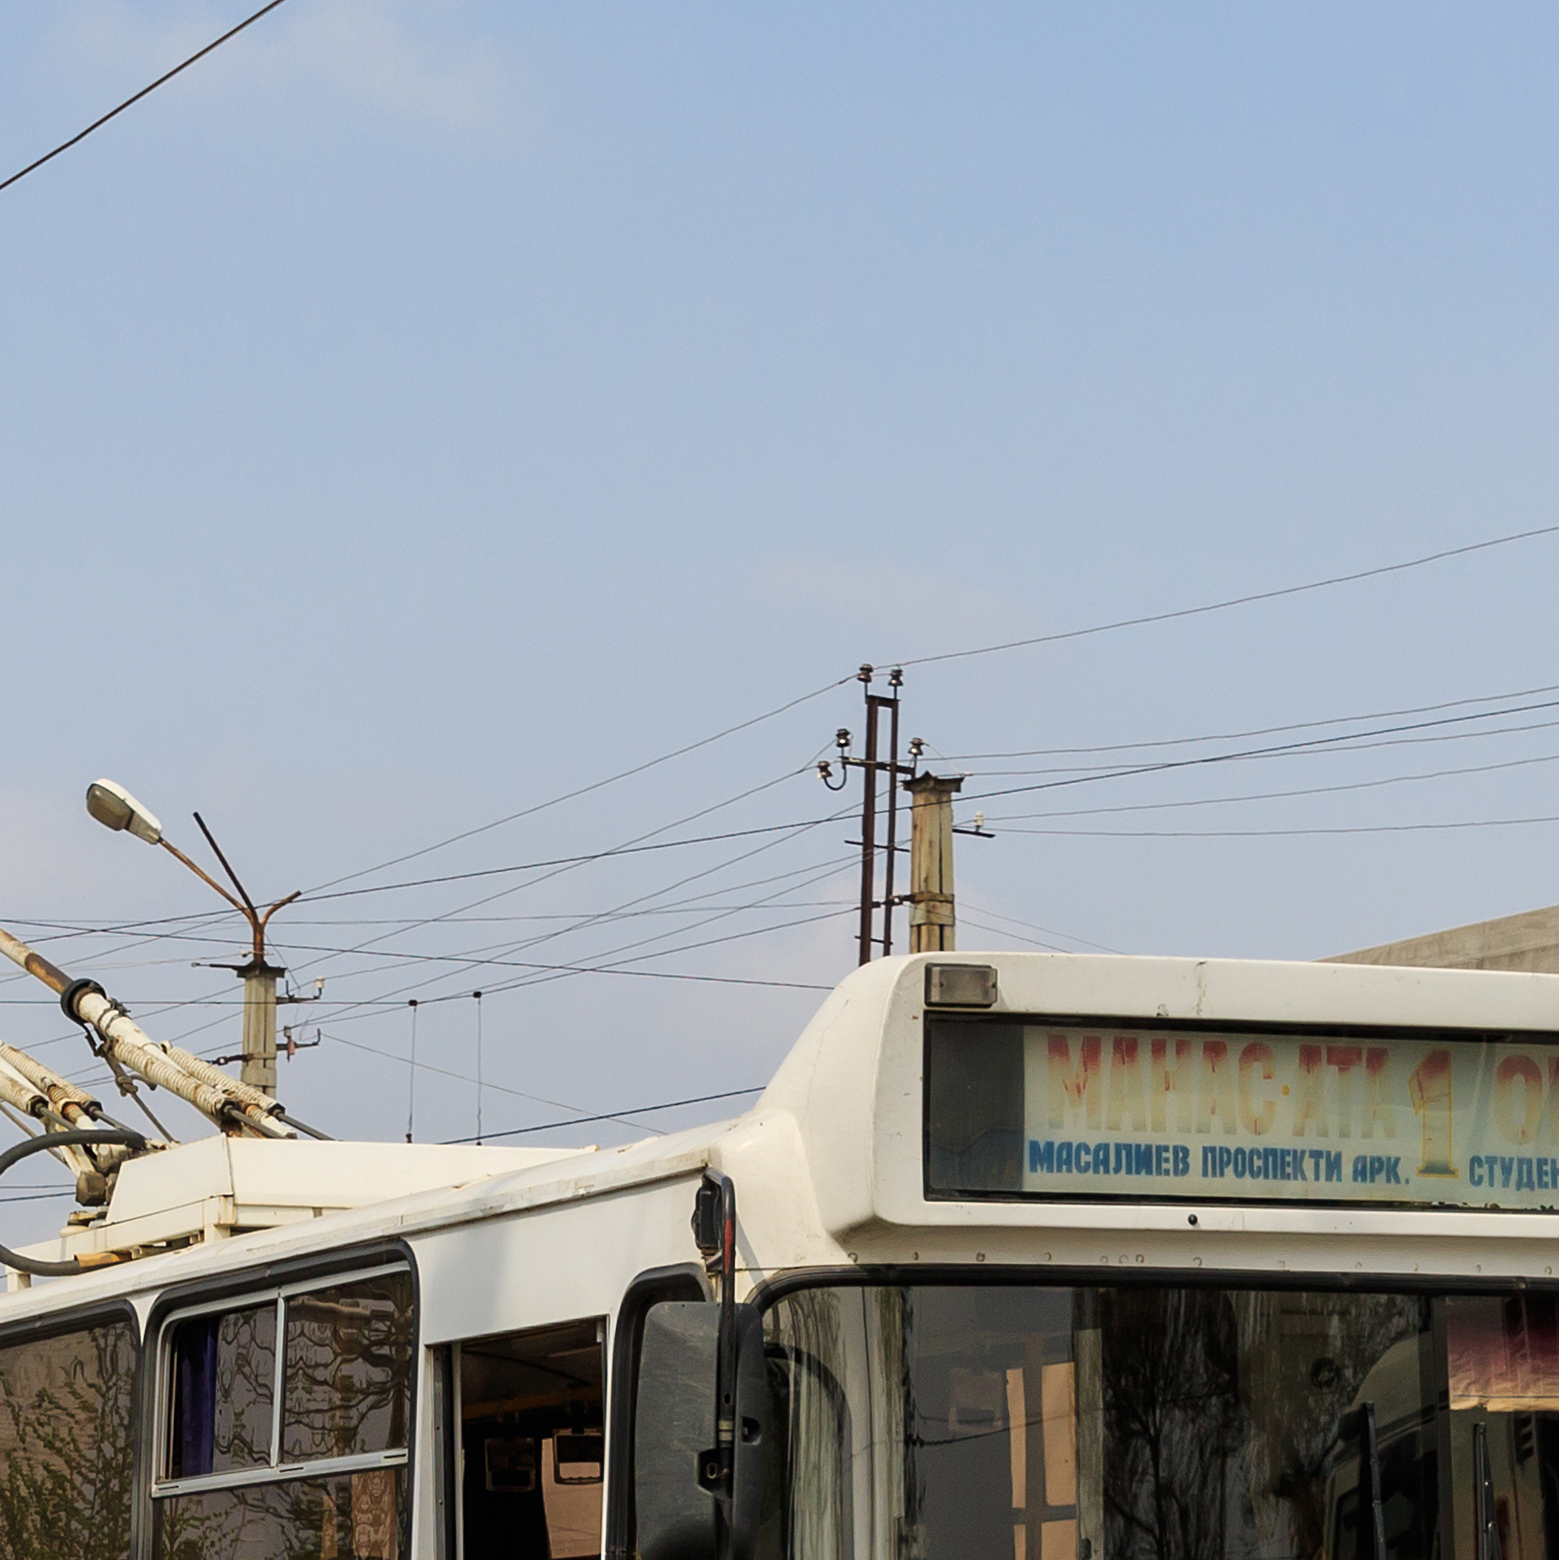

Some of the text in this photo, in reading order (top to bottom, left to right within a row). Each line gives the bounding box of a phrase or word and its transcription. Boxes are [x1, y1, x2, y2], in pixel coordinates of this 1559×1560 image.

[1408, 1047, 1459, 1178] 1
[1028, 1139, 1190, 1176] МАСАЛИЕВ
[1201, 1145, 1342, 1182] ПРОСПЕКТИ
[1352, 1154, 1410, 1185] АРК.
